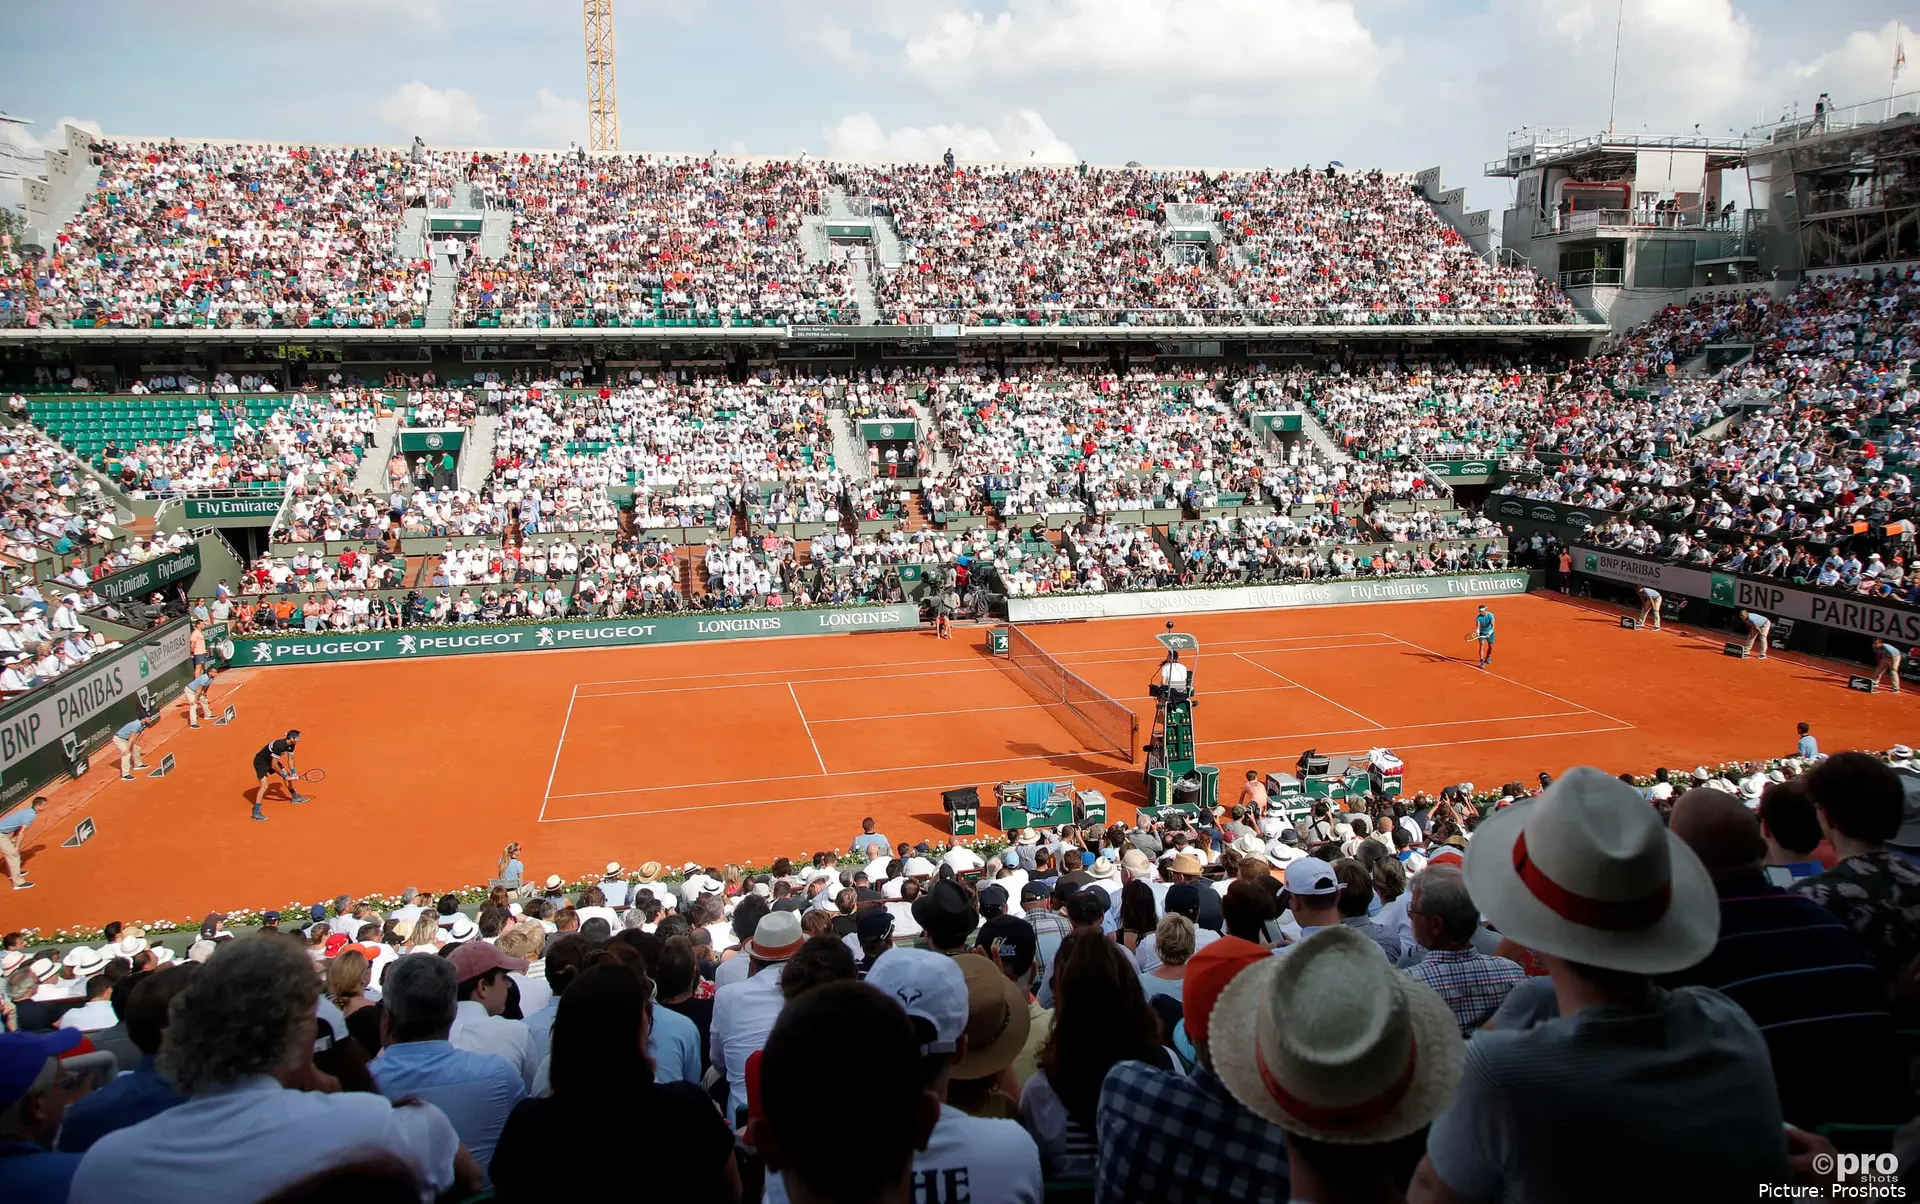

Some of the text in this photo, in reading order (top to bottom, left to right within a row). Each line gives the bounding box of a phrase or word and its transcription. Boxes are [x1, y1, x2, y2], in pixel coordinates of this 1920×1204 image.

[197, 500, 280, 516] Fly Emirates
[157, 554, 196, 580] Fly Emirates
[1600, 556, 1619, 569] BNP
[1621, 560, 1660, 578] PARIBAS
[117, 572, 150, 596] Emirates
[1350, 582, 1429, 599] Fly Emirates
[1446, 577, 1523, 595] Fly Emirates
[1140, 594, 1211, 609] LONGINES
[1271, 585, 1331, 603] Emirates
[1028, 600, 1103, 615] LONGINES
[1738, 582, 1920, 642] BNP PARIBAS
[697, 616, 781, 633] LONGINES
[819, 610, 900, 627] LONGINES
[420, 632, 524, 649] PEUGEOT
[557, 624, 657, 641] PEUGEOT
[149, 647, 163, 666] BNP
[162, 634, 186, 658] PARIBAS
[276, 640, 385, 657] PEUGEOT
[58, 666, 124, 728] PARIBAS
[1, 712, 41, 762] BNP
[2, 777, 29, 802] PARIBAS
